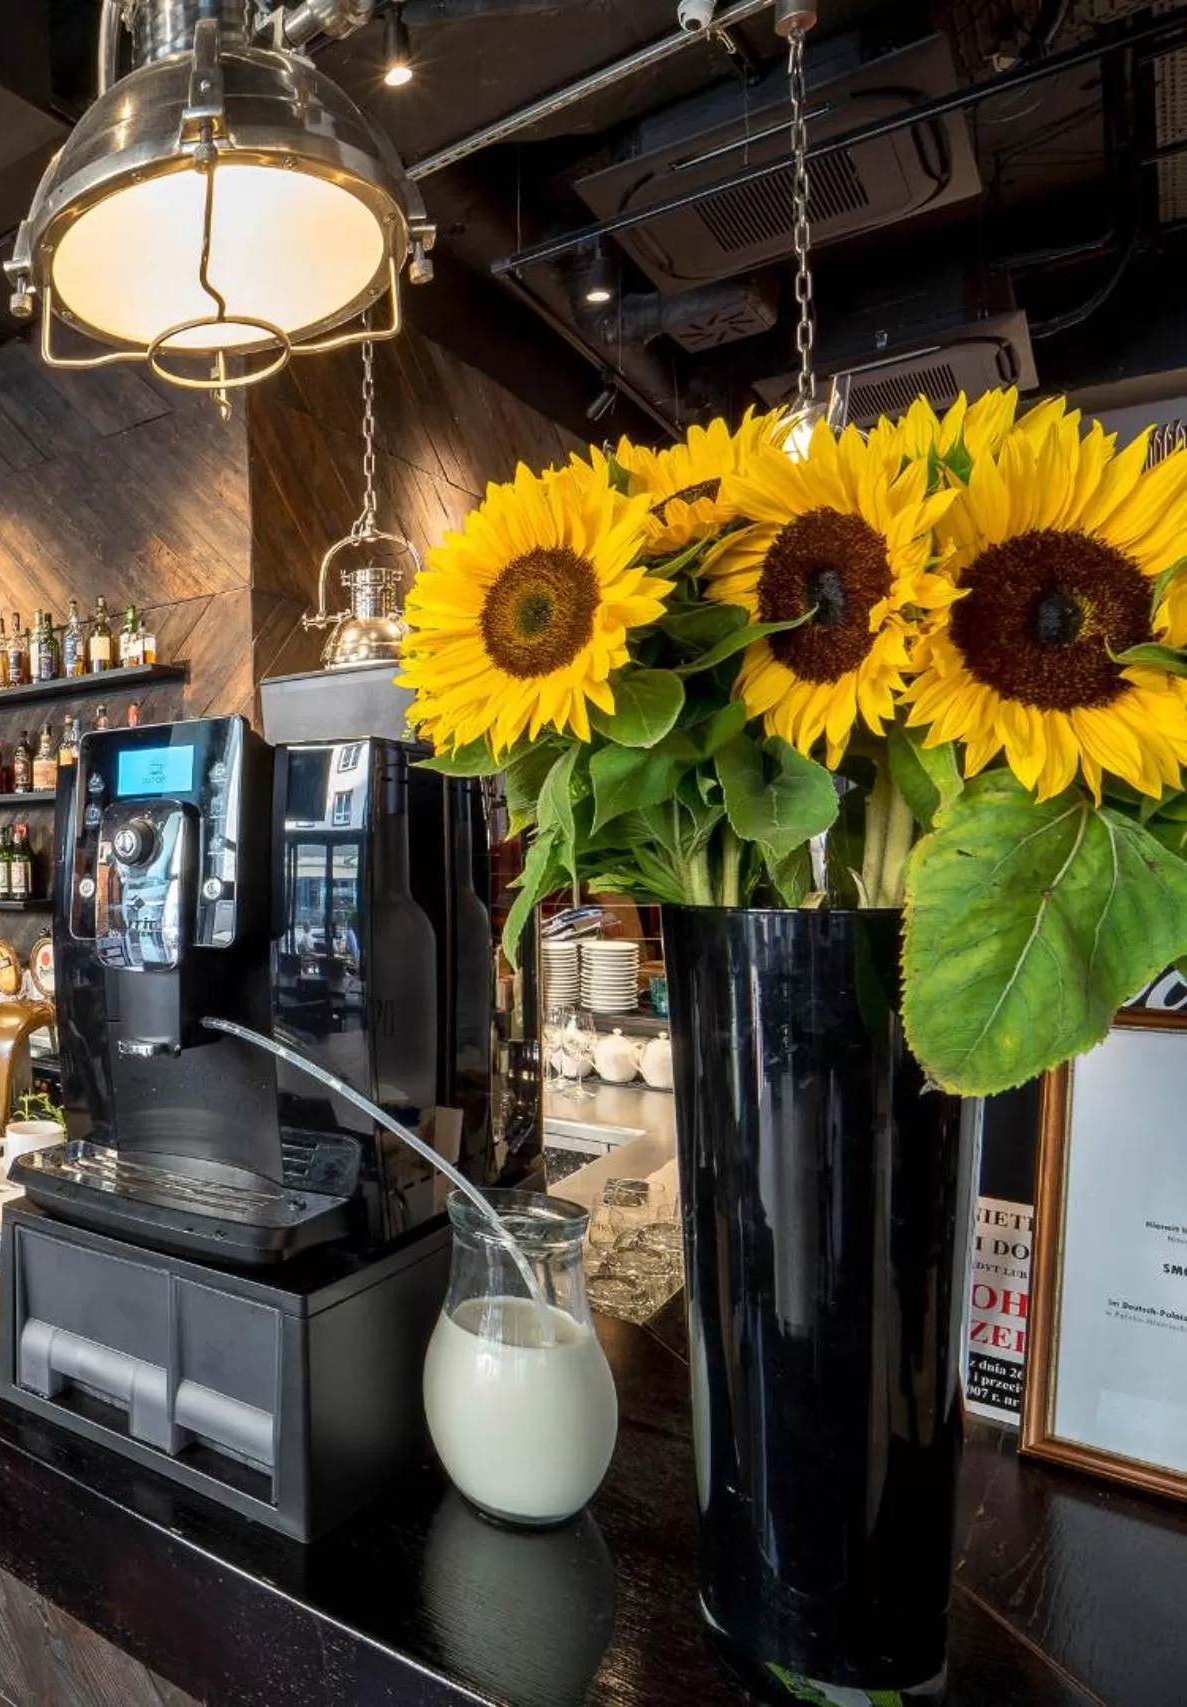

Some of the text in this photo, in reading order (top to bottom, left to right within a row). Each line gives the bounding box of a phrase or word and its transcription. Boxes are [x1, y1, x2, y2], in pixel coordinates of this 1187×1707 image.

[993, 1239, 1030, 1260] DO
[979, 1360, 1006, 1375] dnia
[981, 1375, 1023, 1393] przeci
[1004, 1396, 1020, 1407] nr
